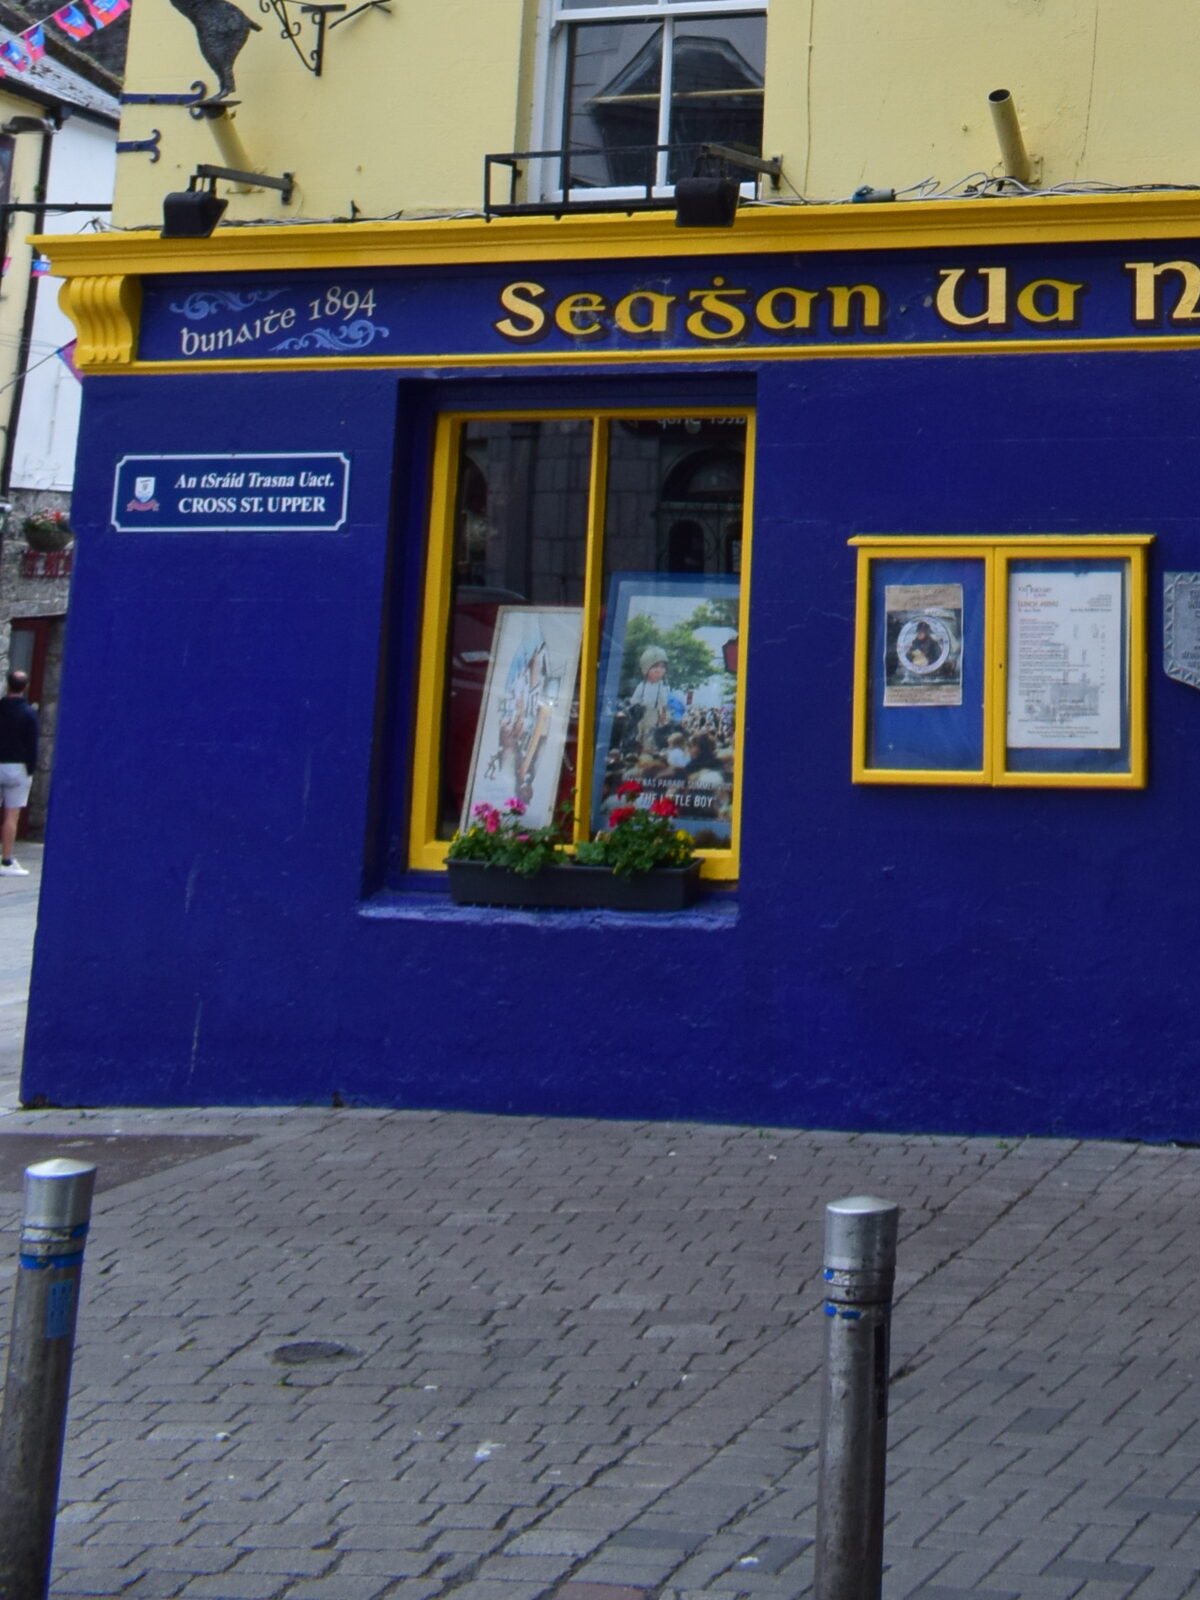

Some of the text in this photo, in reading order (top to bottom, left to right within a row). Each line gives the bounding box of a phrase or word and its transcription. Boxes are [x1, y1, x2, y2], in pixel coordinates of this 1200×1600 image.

[308, 286, 377, 322] 1894
[936, 267, 1083, 326] Ua
[175, 471, 335, 489] An tSráid Trasna Uact.
[178, 496, 326, 514] CROSS ST. UPPER
[693, 794, 713, 808] BOY
